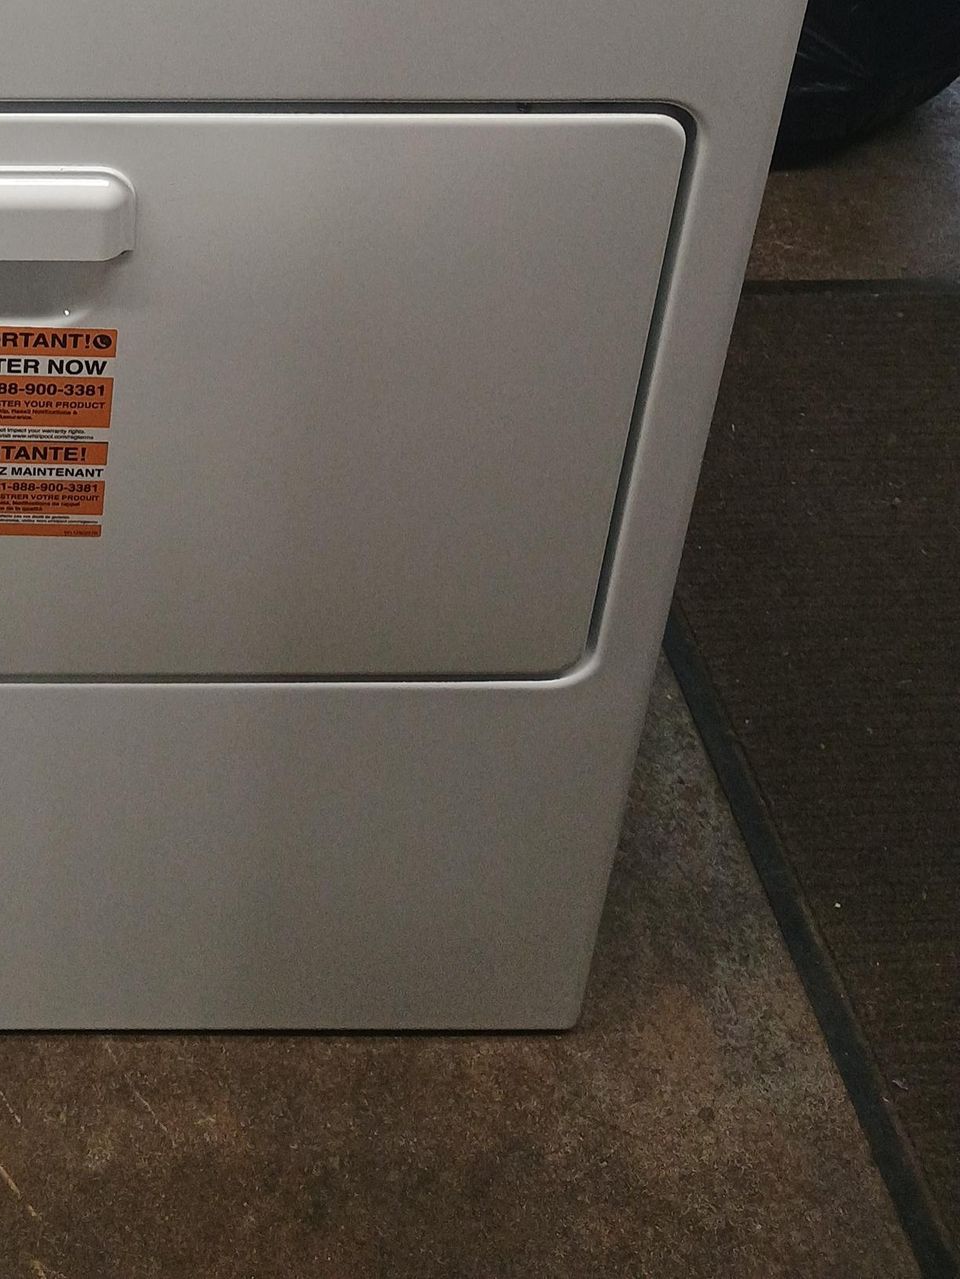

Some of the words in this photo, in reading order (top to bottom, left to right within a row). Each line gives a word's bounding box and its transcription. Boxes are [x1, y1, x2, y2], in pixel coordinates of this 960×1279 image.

[47, 359, 108, 376] NOW
[24, 400, 54, 409] YOUR
[55, 400, 106, 410] PRODUCT
[11, 465, 105, 478] MAINTENANT
[0, 482, 99, 494] 1-888-900-3381
[30, 493, 60, 502] VOTRE
[60, 494, 101, 503] PRODUIT
